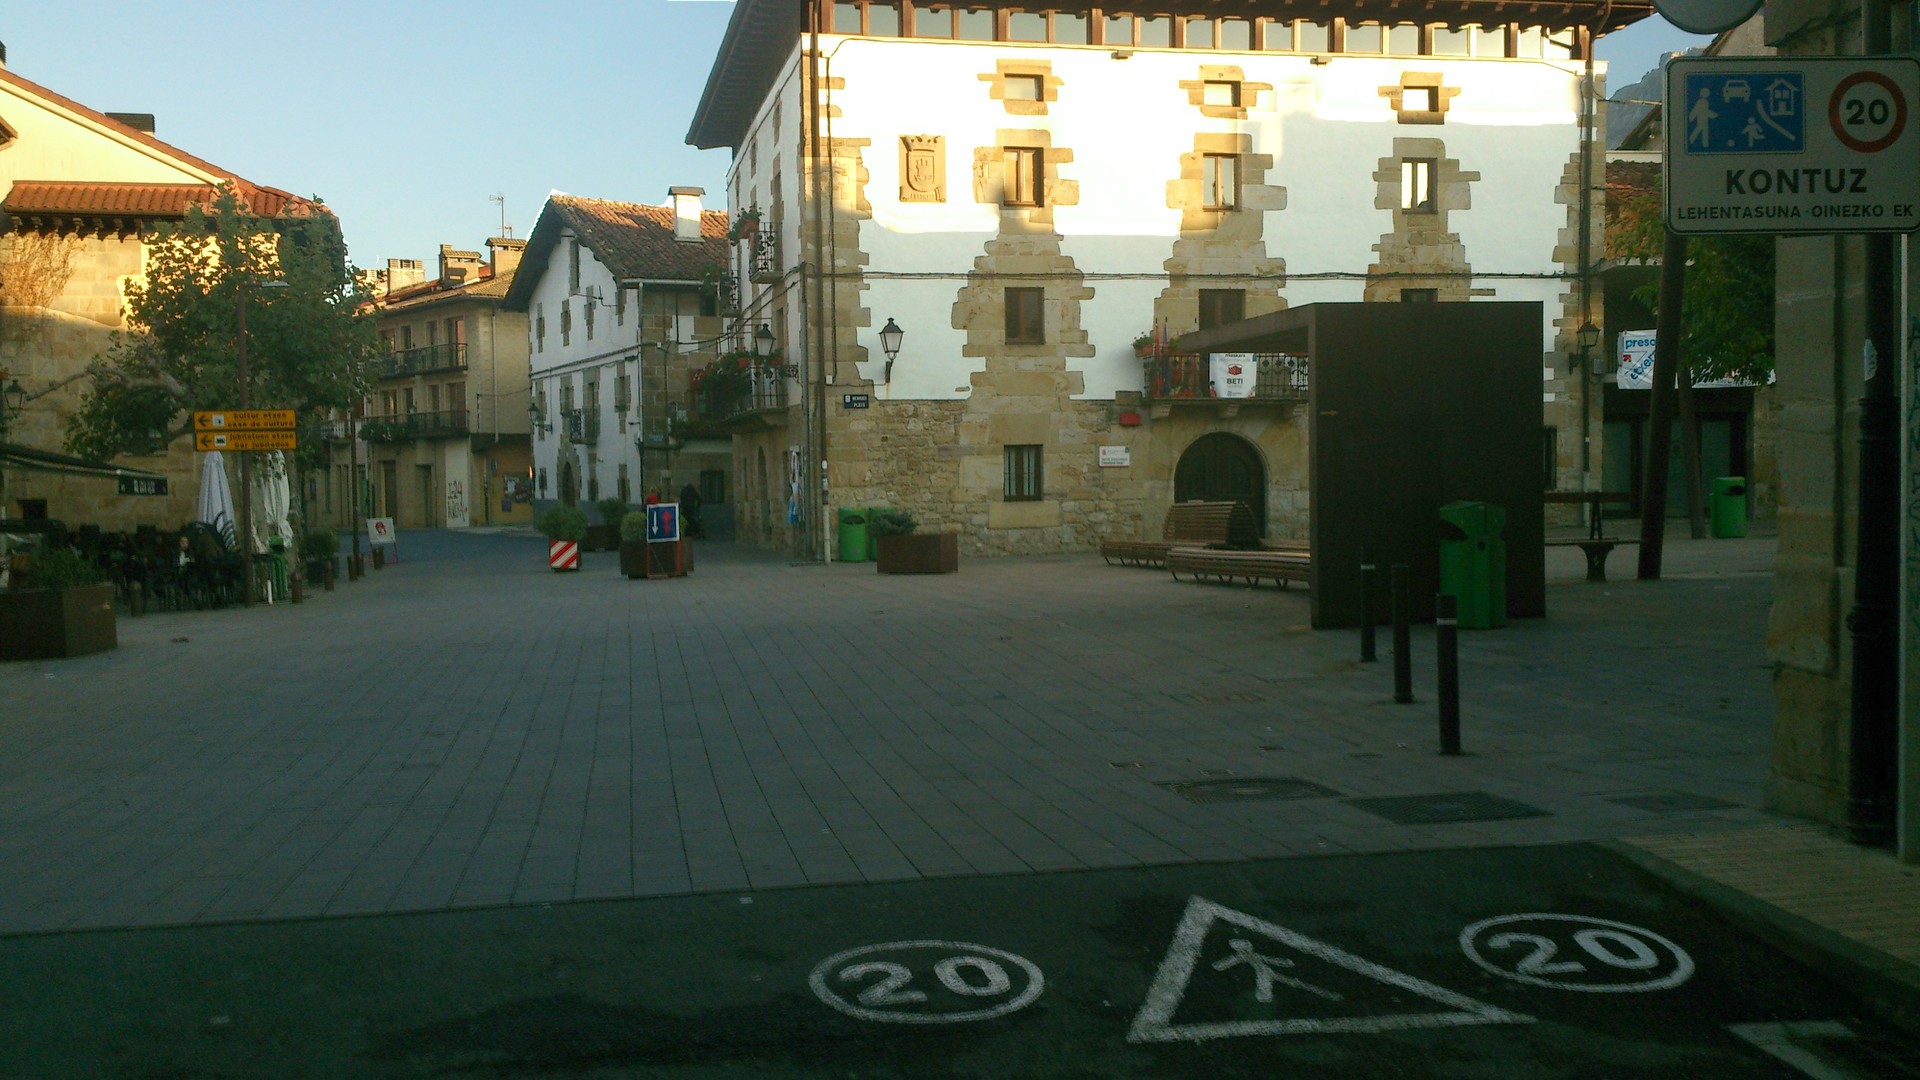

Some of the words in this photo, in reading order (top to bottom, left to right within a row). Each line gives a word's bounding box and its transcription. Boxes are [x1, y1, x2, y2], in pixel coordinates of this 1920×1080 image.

[1845, 98, 1890, 126] 20
[1725, 167, 1868, 195] KONTUZ
[1677, 204, 1801, 220] LEHENTASUNA
[1893, 203, 1914, 217] EK
[1226, 377, 1244, 385] BETI
[233, 411, 260, 419] kultur
[263, 411, 287, 419] etxea
[272, 432, 294, 440] etxea
[1487, 928, 1659, 975] 20
[838, 955, 1011, 1006] 20
